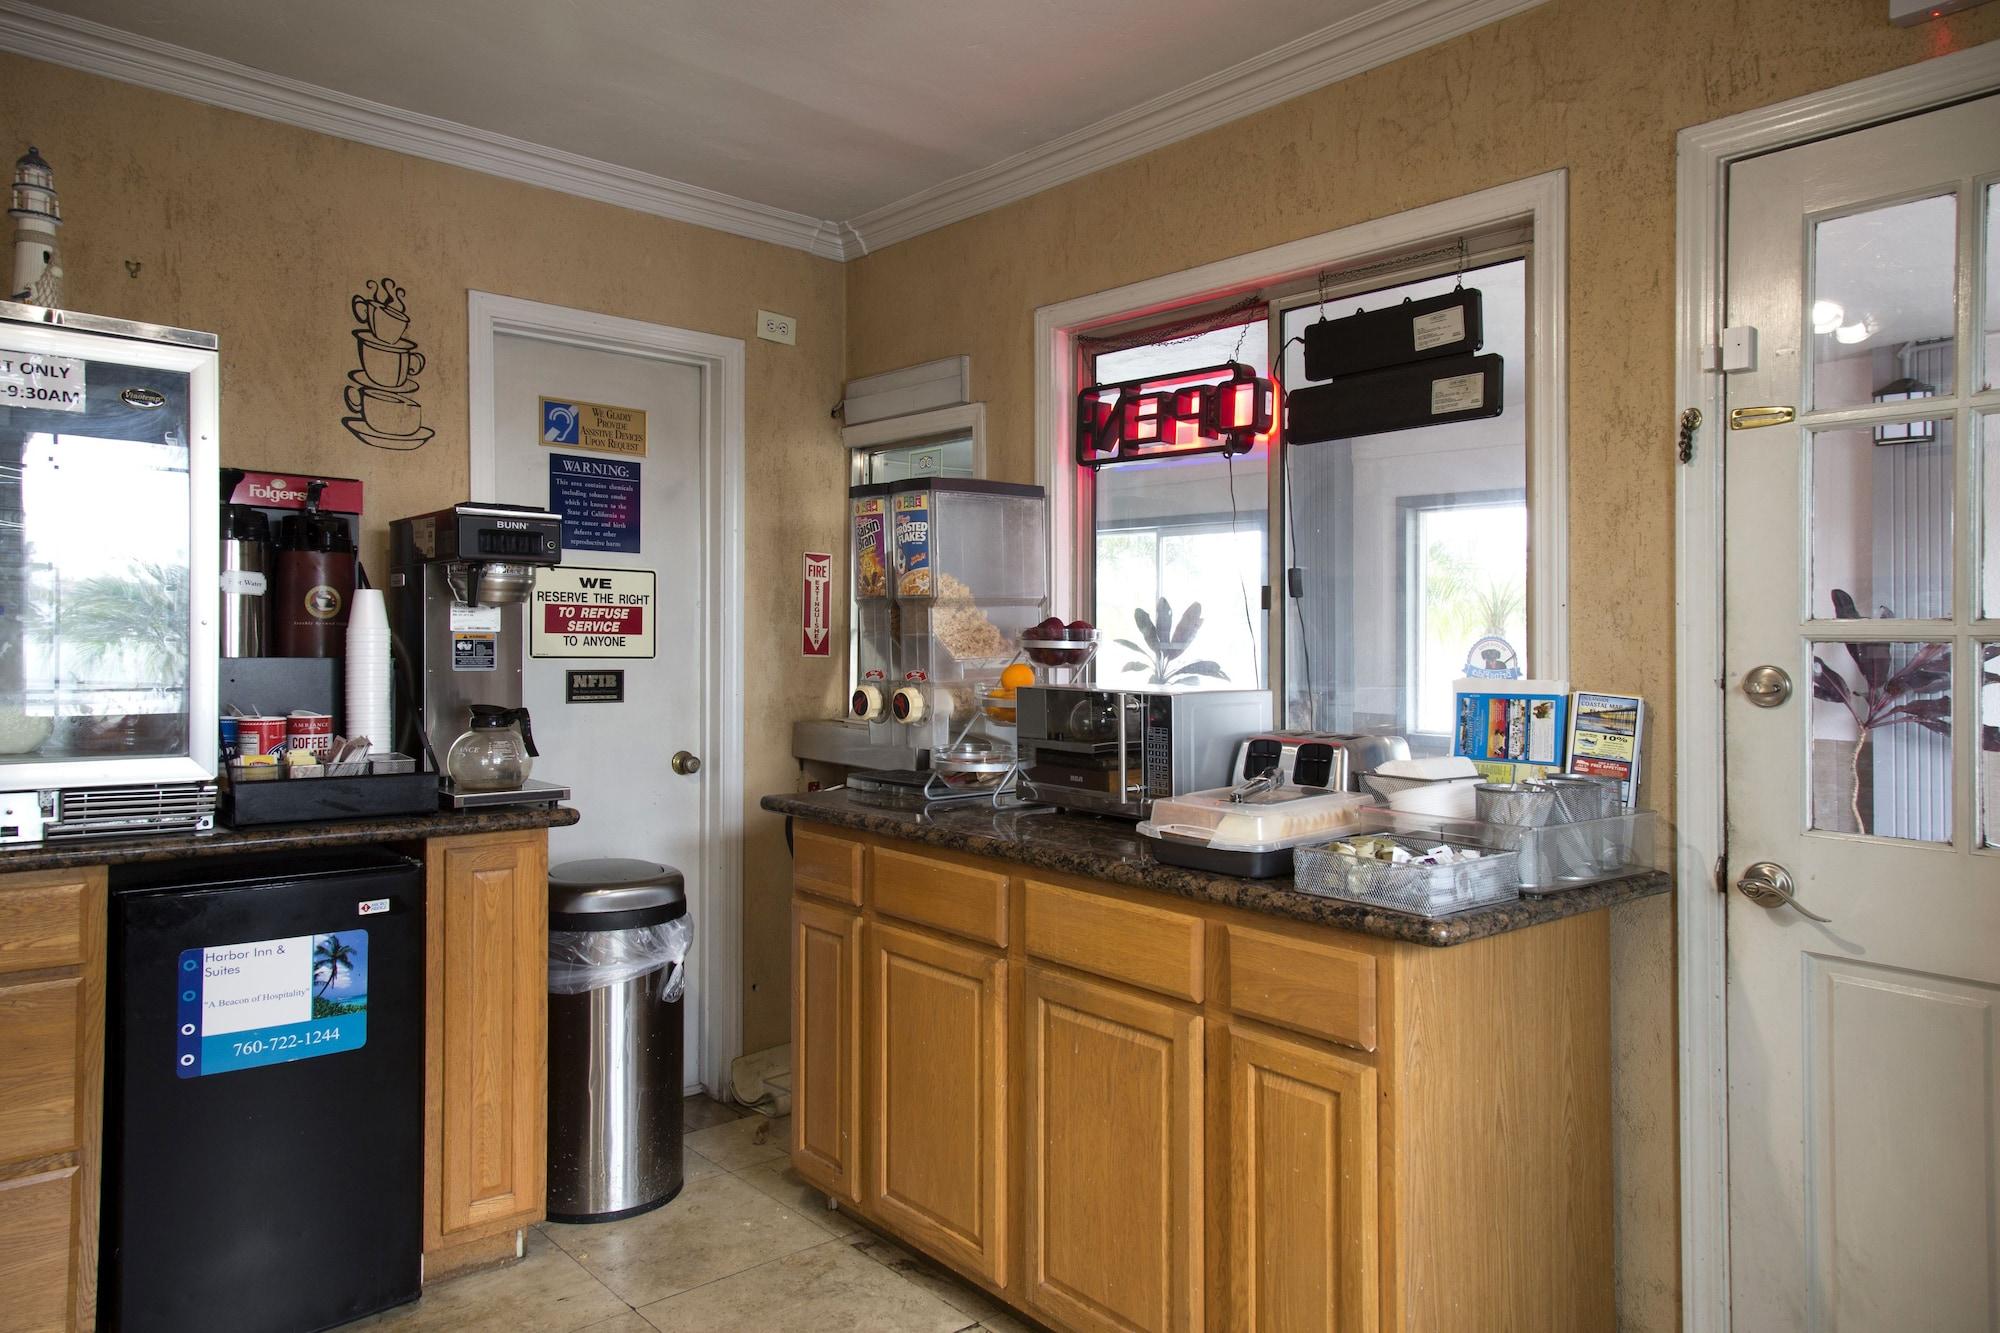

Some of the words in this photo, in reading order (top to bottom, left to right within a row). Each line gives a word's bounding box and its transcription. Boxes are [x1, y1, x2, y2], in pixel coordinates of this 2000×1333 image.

[20, 362, 70, 378] ONLY
[563, 460, 629, 477] WARNING:
[250, 483, 306, 502] Folgers
[609, 483, 634, 492] chemicals
[562, 489, 587, 498] including
[589, 491, 609, 499] tobacco
[567, 508, 580, 516] State
[591, 510, 617, 519] California
[496, 521, 527, 530] BUNN
[613, 521, 626, 529] birth
[897, 521, 928, 535] FROSTED
[603, 530, 616, 538] other
[898, 531, 926, 544] FLAKES
[571, 539, 605, 547] reproductive
[808, 564, 827, 578] FIRE
[579, 577, 612, 589] WE
[537, 591, 588, 603] RESERVE
[594, 593, 614, 604] THE
[619, 594, 650, 605] RIGHT
[558, 607, 575, 618] TO
[580, 608, 629, 620] REFUSE
[567, 620, 620, 632] SERVICE
[563, 636, 577, 647] TO
[583, 636, 626, 647] ANYONE
[573, 674, 617, 688] NFIB
[1581, 701, 1607, 709] COASTAL
[292, 737, 329, 749] COFFEE
[1602, 735, 1628, 744] 10%
[205, 949, 249, 962] Harbor
[254, 947, 273, 957] Inn
[277, 945, 286, 955] &
[204, 966, 241, 978] Suites
[219, 997, 249, 1008] Beacon
[251, 994, 262, 1004] of
[232, 1027, 340, 1056] 760-722-1244
